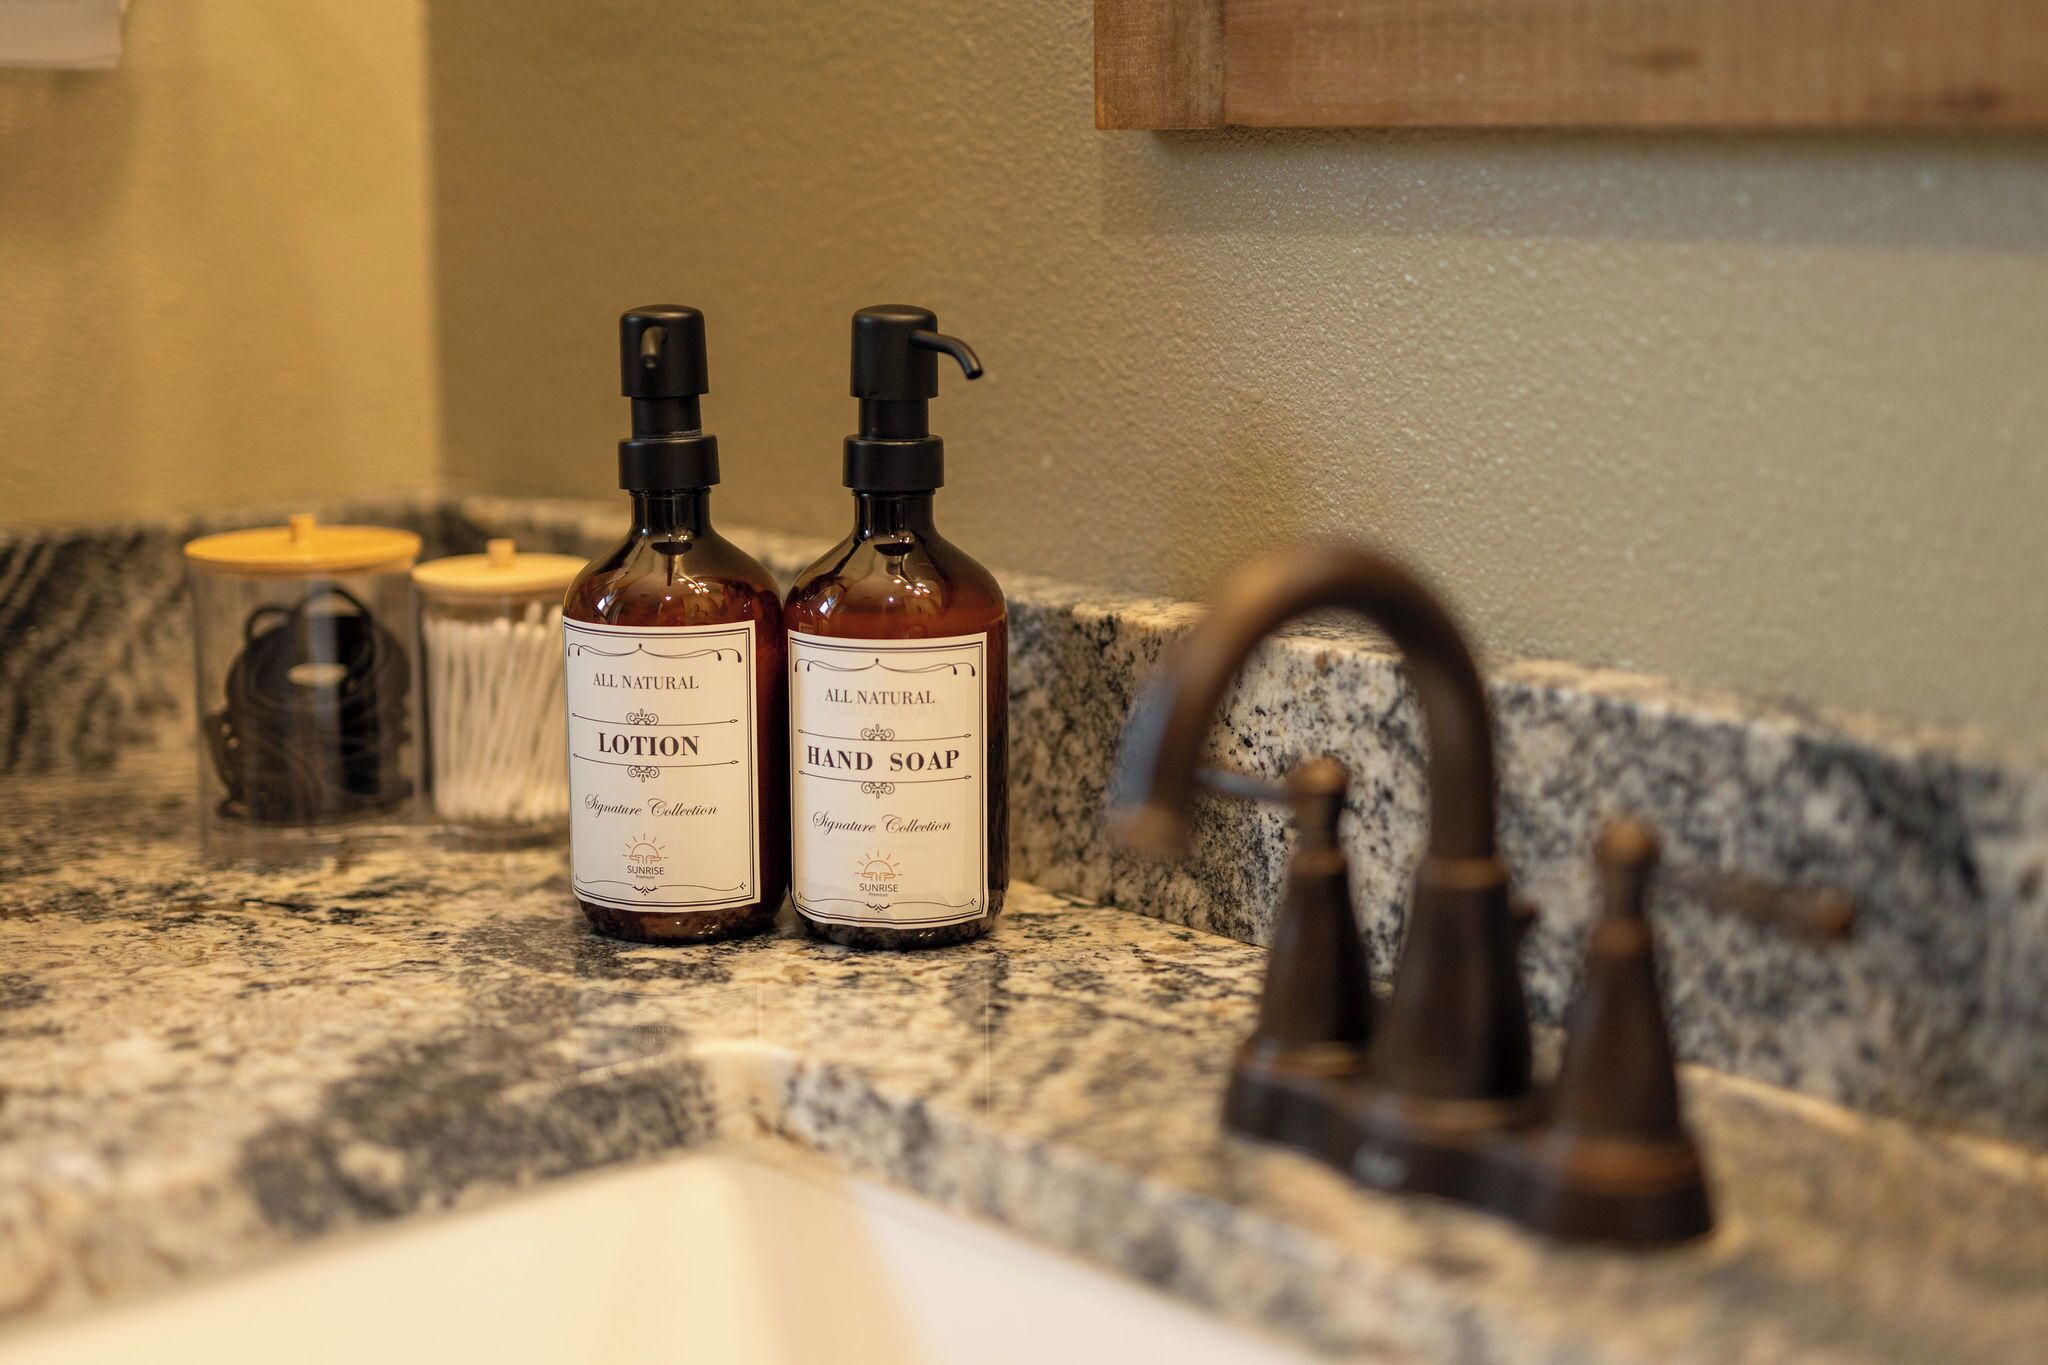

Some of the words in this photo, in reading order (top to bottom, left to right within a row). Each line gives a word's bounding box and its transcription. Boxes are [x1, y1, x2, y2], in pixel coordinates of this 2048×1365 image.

[594, 673, 618, 689] ALL
[621, 675, 700, 691] NATURAL
[825, 688, 852, 703] ALL
[858, 690, 936, 706] NATURAL
[598, 732, 700, 756] LOTION
[807, 745, 873, 771] HAND
[890, 750, 959, 772] SOAP
[585, 794, 643, 819] Signature
[647, 798, 718, 817] Collection
[813, 811, 876, 836] Signature
[881, 815, 951, 833] Collection
[627, 865, 665, 876] SUNRISE
[859, 882, 899, 893] SUNRISE
